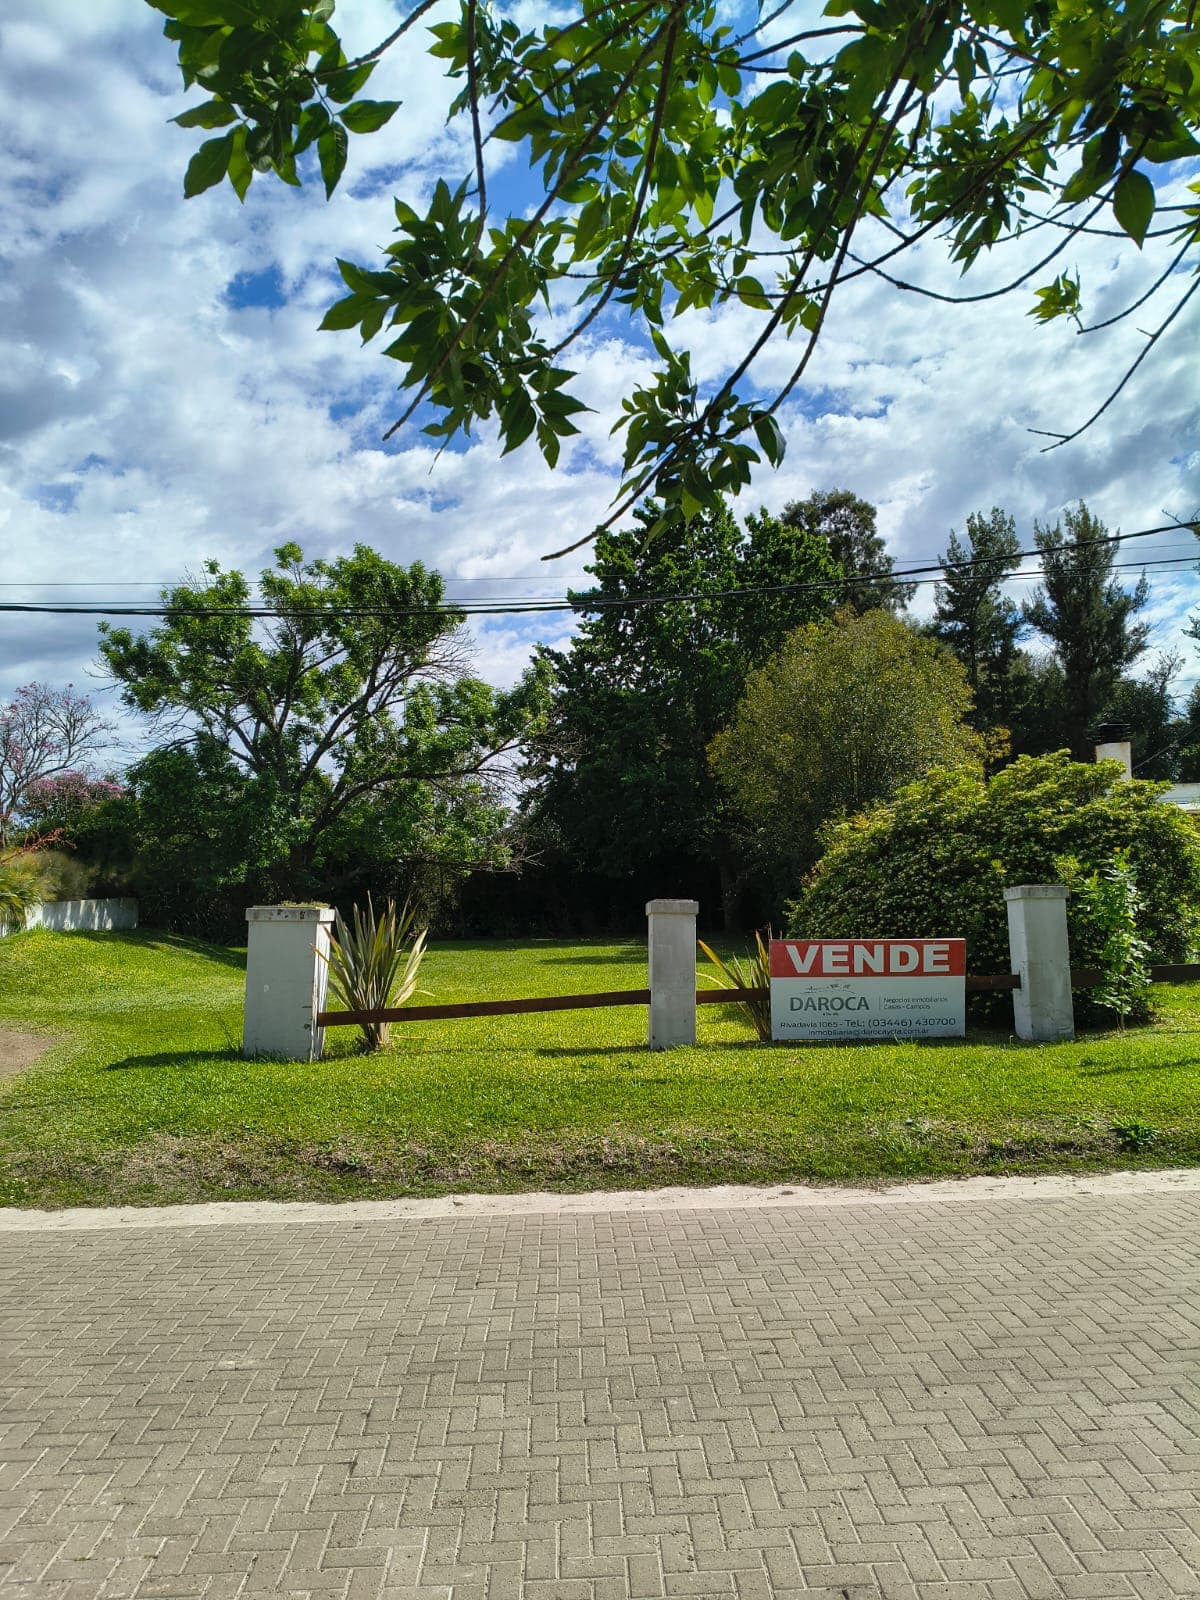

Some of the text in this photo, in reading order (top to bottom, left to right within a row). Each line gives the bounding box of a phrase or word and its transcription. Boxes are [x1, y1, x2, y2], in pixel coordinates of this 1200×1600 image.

[785, 944, 950, 974] VENDE
[790, 996, 870, 1012] DAROCA
[906, 1003, 931, 1011] Campos
[780, 1021, 818, 1029] Rivadavia
[867, 1018, 913, 1029] (03446)
[915, 1017, 957, 1027] 430700
